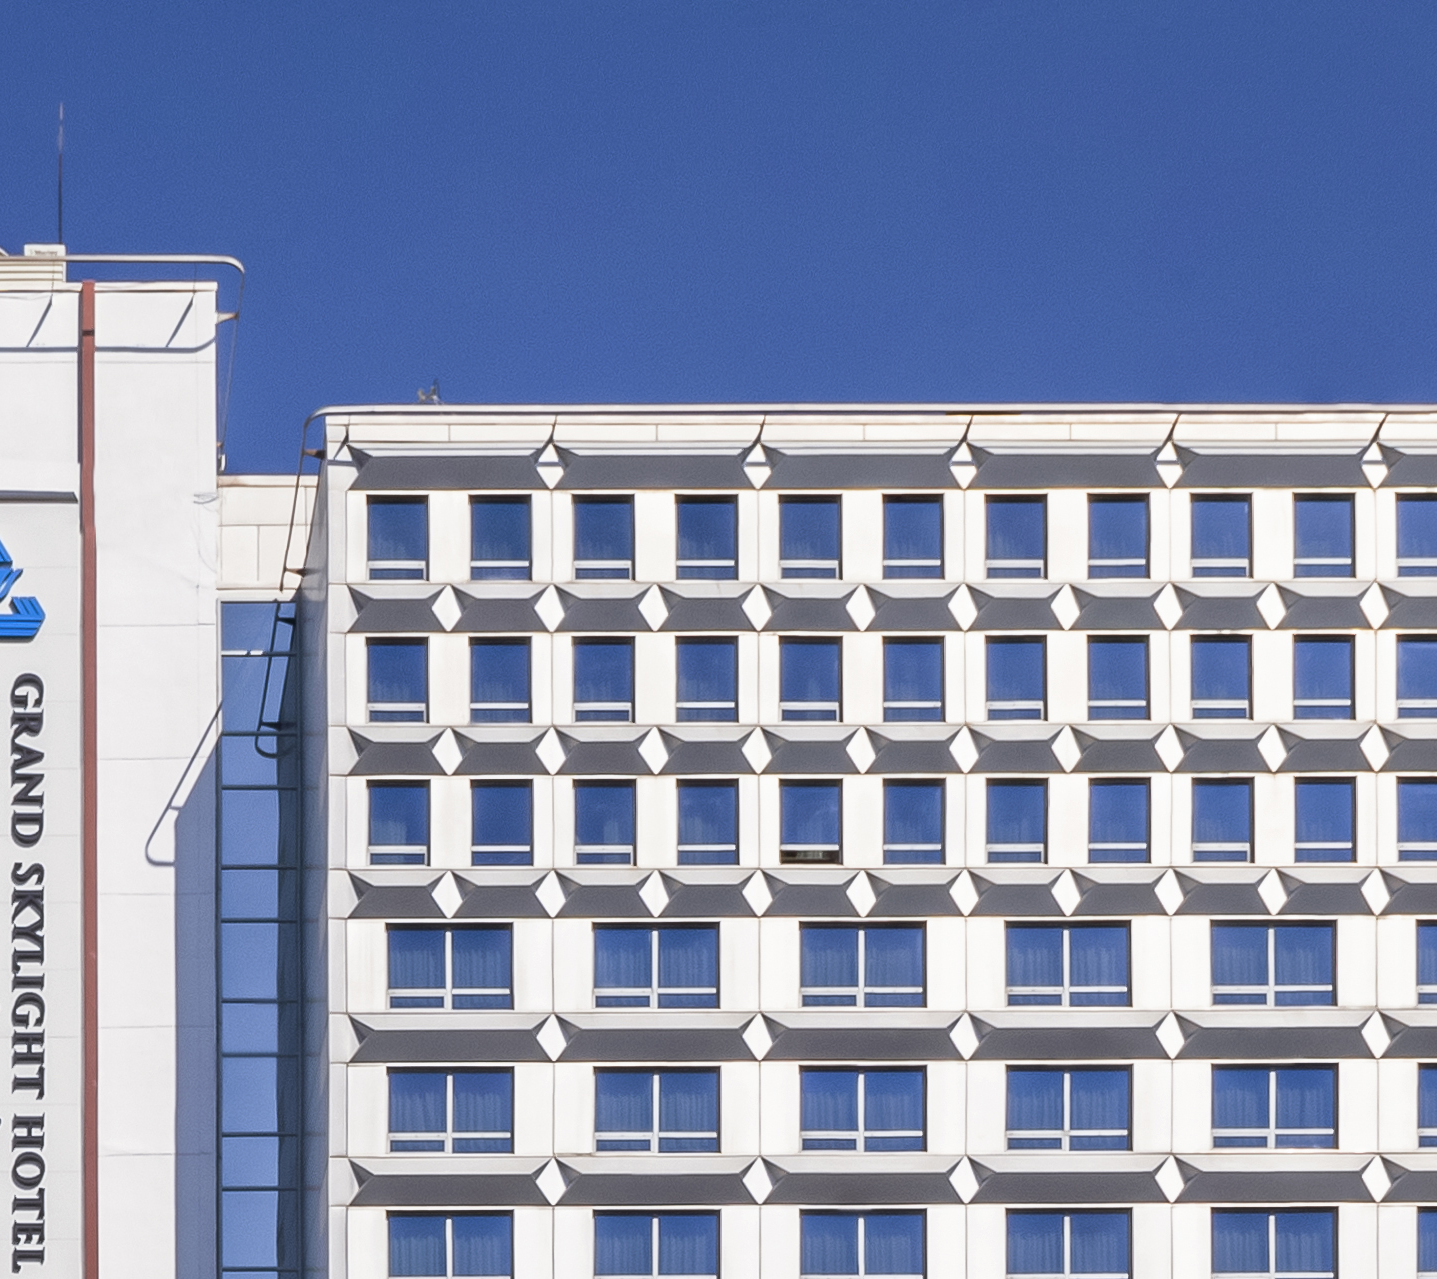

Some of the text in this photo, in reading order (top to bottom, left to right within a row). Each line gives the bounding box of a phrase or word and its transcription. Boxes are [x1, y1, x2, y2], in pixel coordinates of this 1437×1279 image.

[10, 673, 45, 1274] GRAND SKYLIGHT HOTEL
